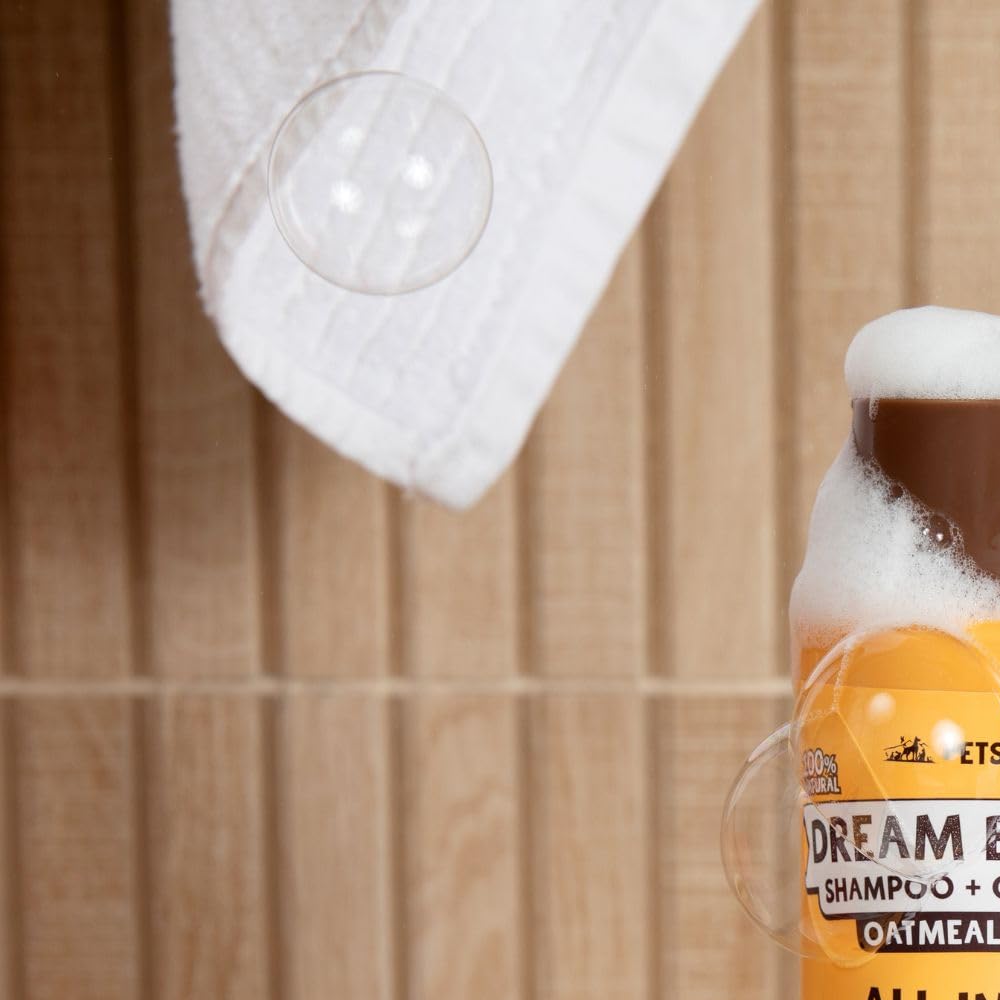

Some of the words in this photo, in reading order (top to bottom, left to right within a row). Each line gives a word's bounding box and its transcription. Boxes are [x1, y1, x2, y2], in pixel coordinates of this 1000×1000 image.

[812, 814, 964, 863] DREAM
[825, 875, 954, 903] SHAMPOO
[966, 880, 980, 895] +
[863, 920, 1000, 945] OATMEAL
